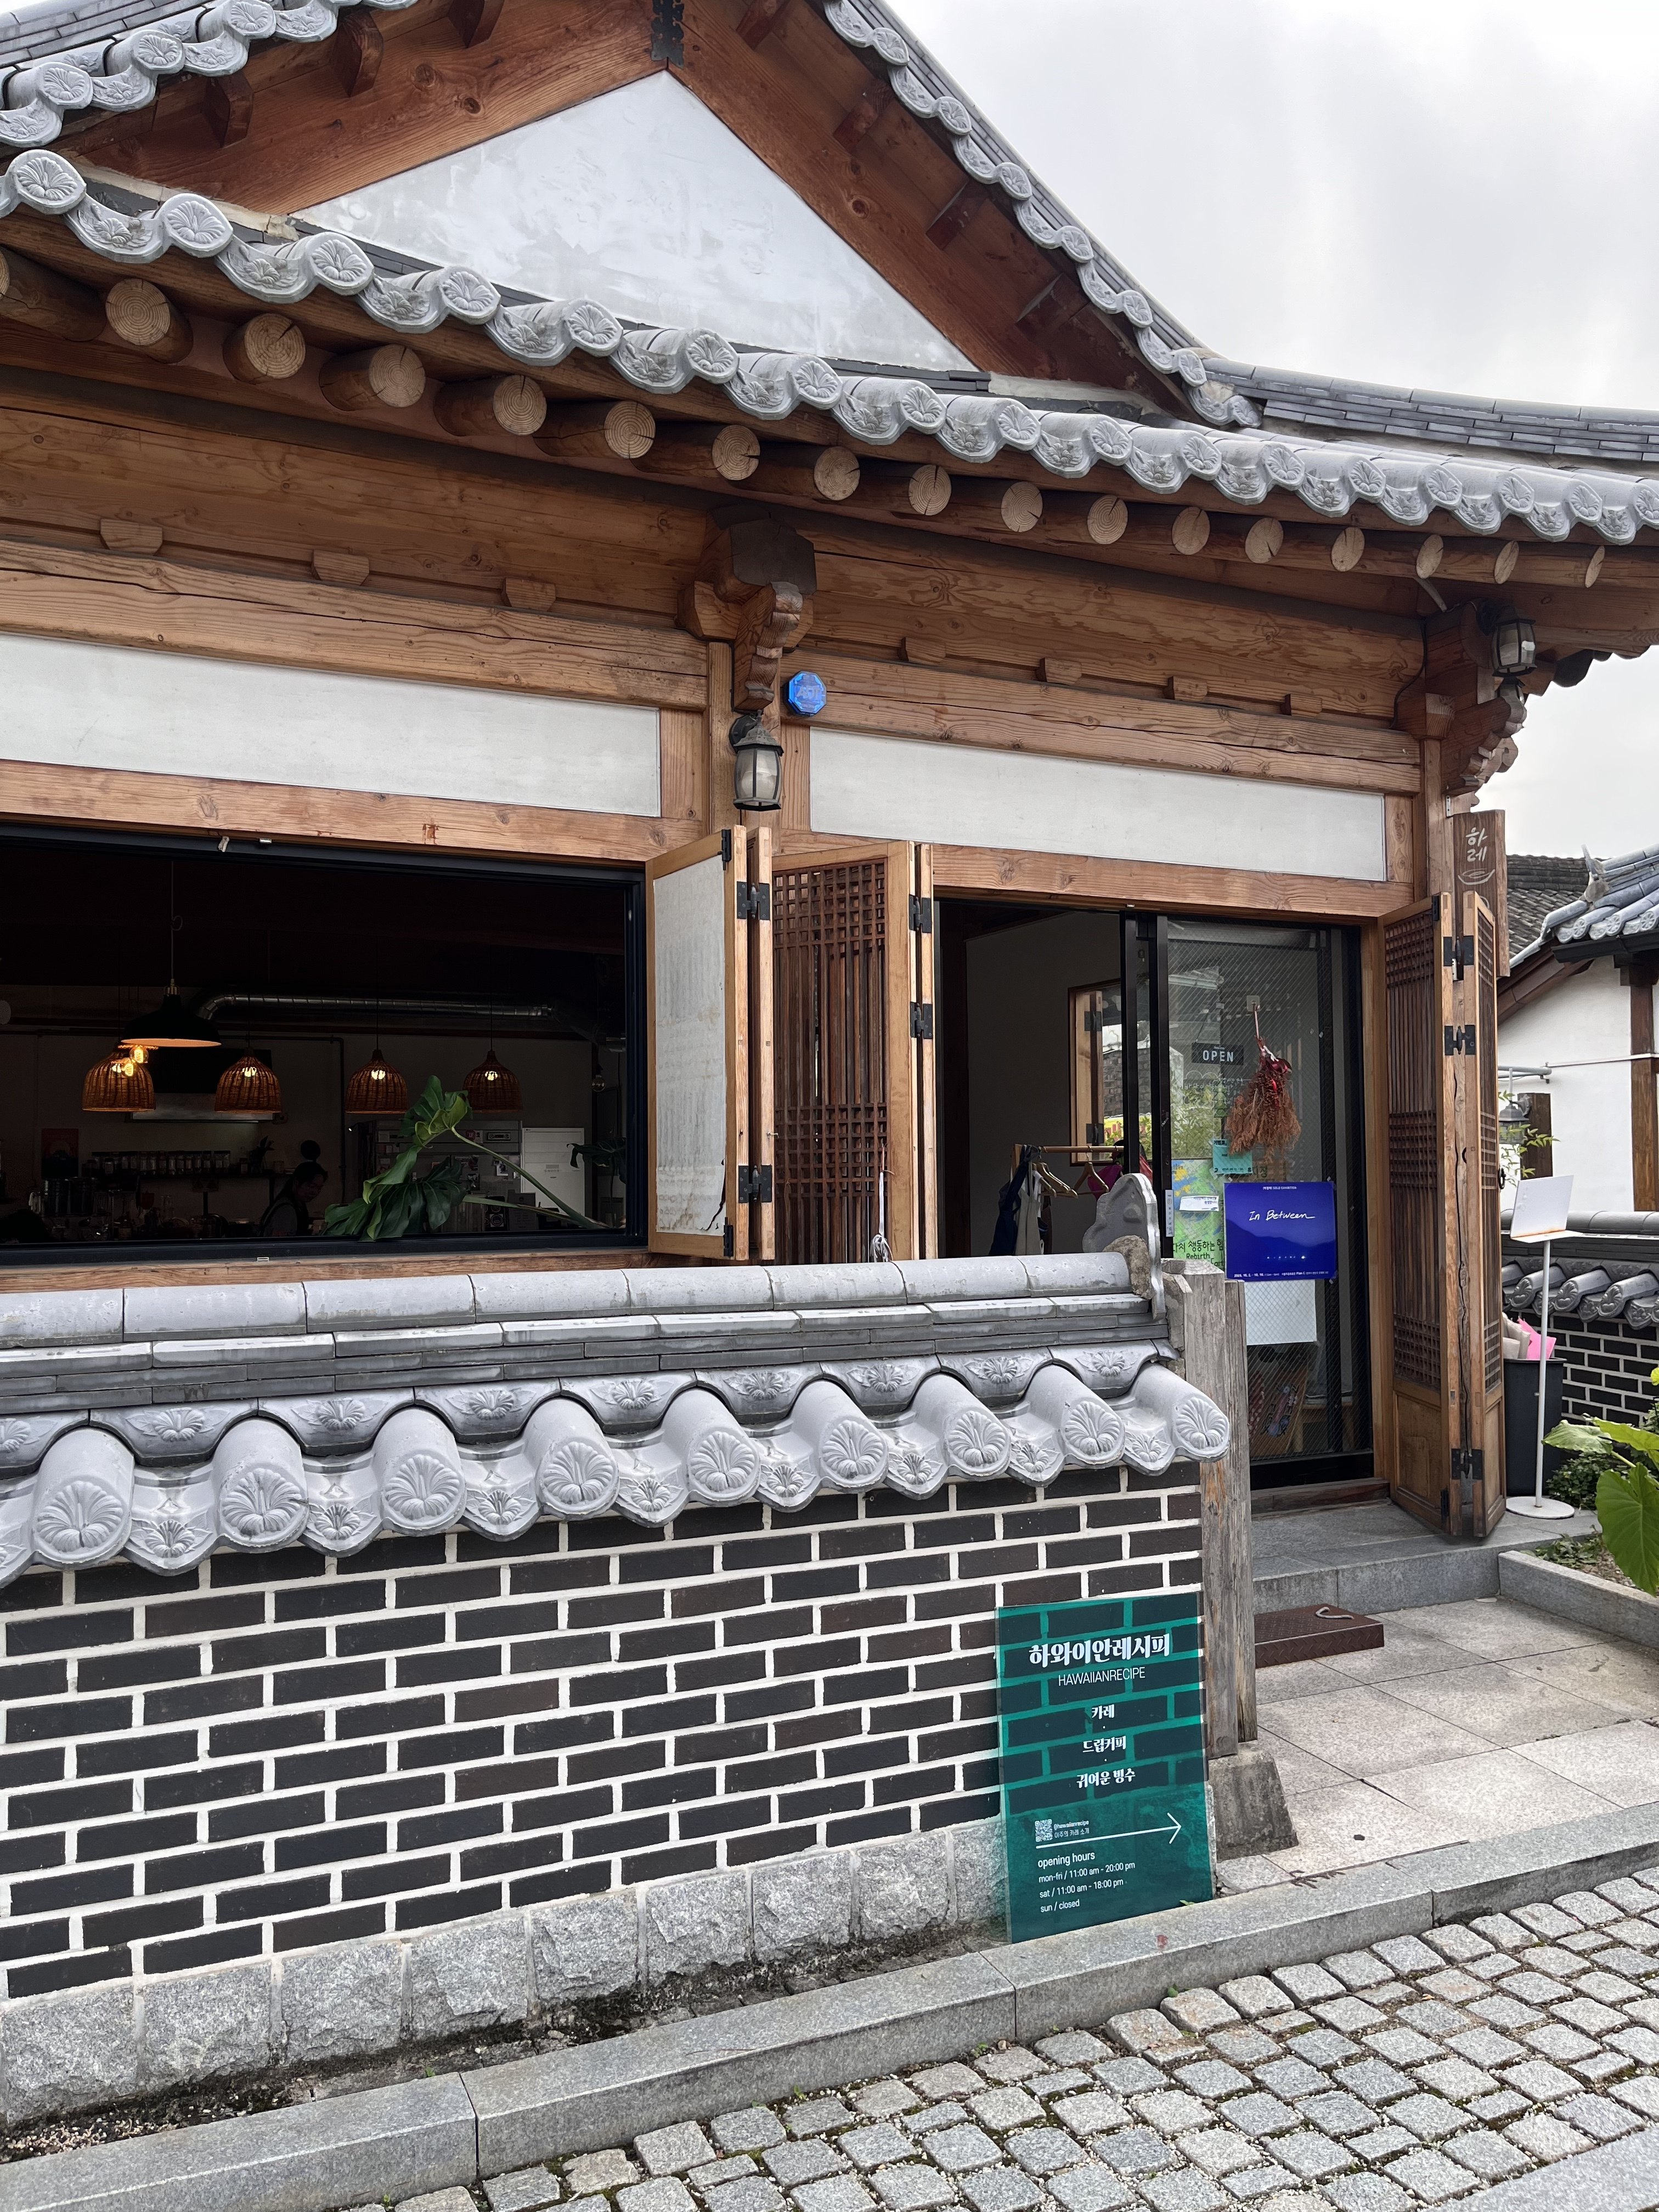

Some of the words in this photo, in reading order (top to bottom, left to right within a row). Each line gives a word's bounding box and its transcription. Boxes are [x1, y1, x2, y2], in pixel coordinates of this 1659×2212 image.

[1203, 1050, 1233, 1062] OPEN
[1249, 1211, 1260, 1221] In
[1266, 1209, 1316, 1221] Between
[1188, 1239, 1215, 1252] 생동하는
[1029, 1633, 1170, 1668] 하와이안레시피
[1058, 1667, 1146, 1686] HAWAIIANRECIPE
[1091, 1704, 1114, 1719] 카레
[1082, 1735, 1126, 1752] 드립커피
[1076, 1771, 1111, 1788] 귀여운
[1113, 1768, 1136, 1784] 빙수
[1038, 1855, 1070, 1869] opening
[1073, 1852, 1096, 1863] hours
[1039, 1872, 1063, 1883] mon-fri
[1069, 1868, 1087, 1878] 11:00
[1105, 1863, 1124, 1872] 20:00
[1125, 1862, 1136, 1871] pm
[1040, 1889, 1050, 1898] sat
[1057, 1885, 1075, 1895] 11:00
[1093, 1880, 1112, 1889] 18:00
[1113, 1879, 1124, 1888] pm
[1040, 1904, 1053, 1912] sun
[1058, 1899, 1080, 1910] closed
